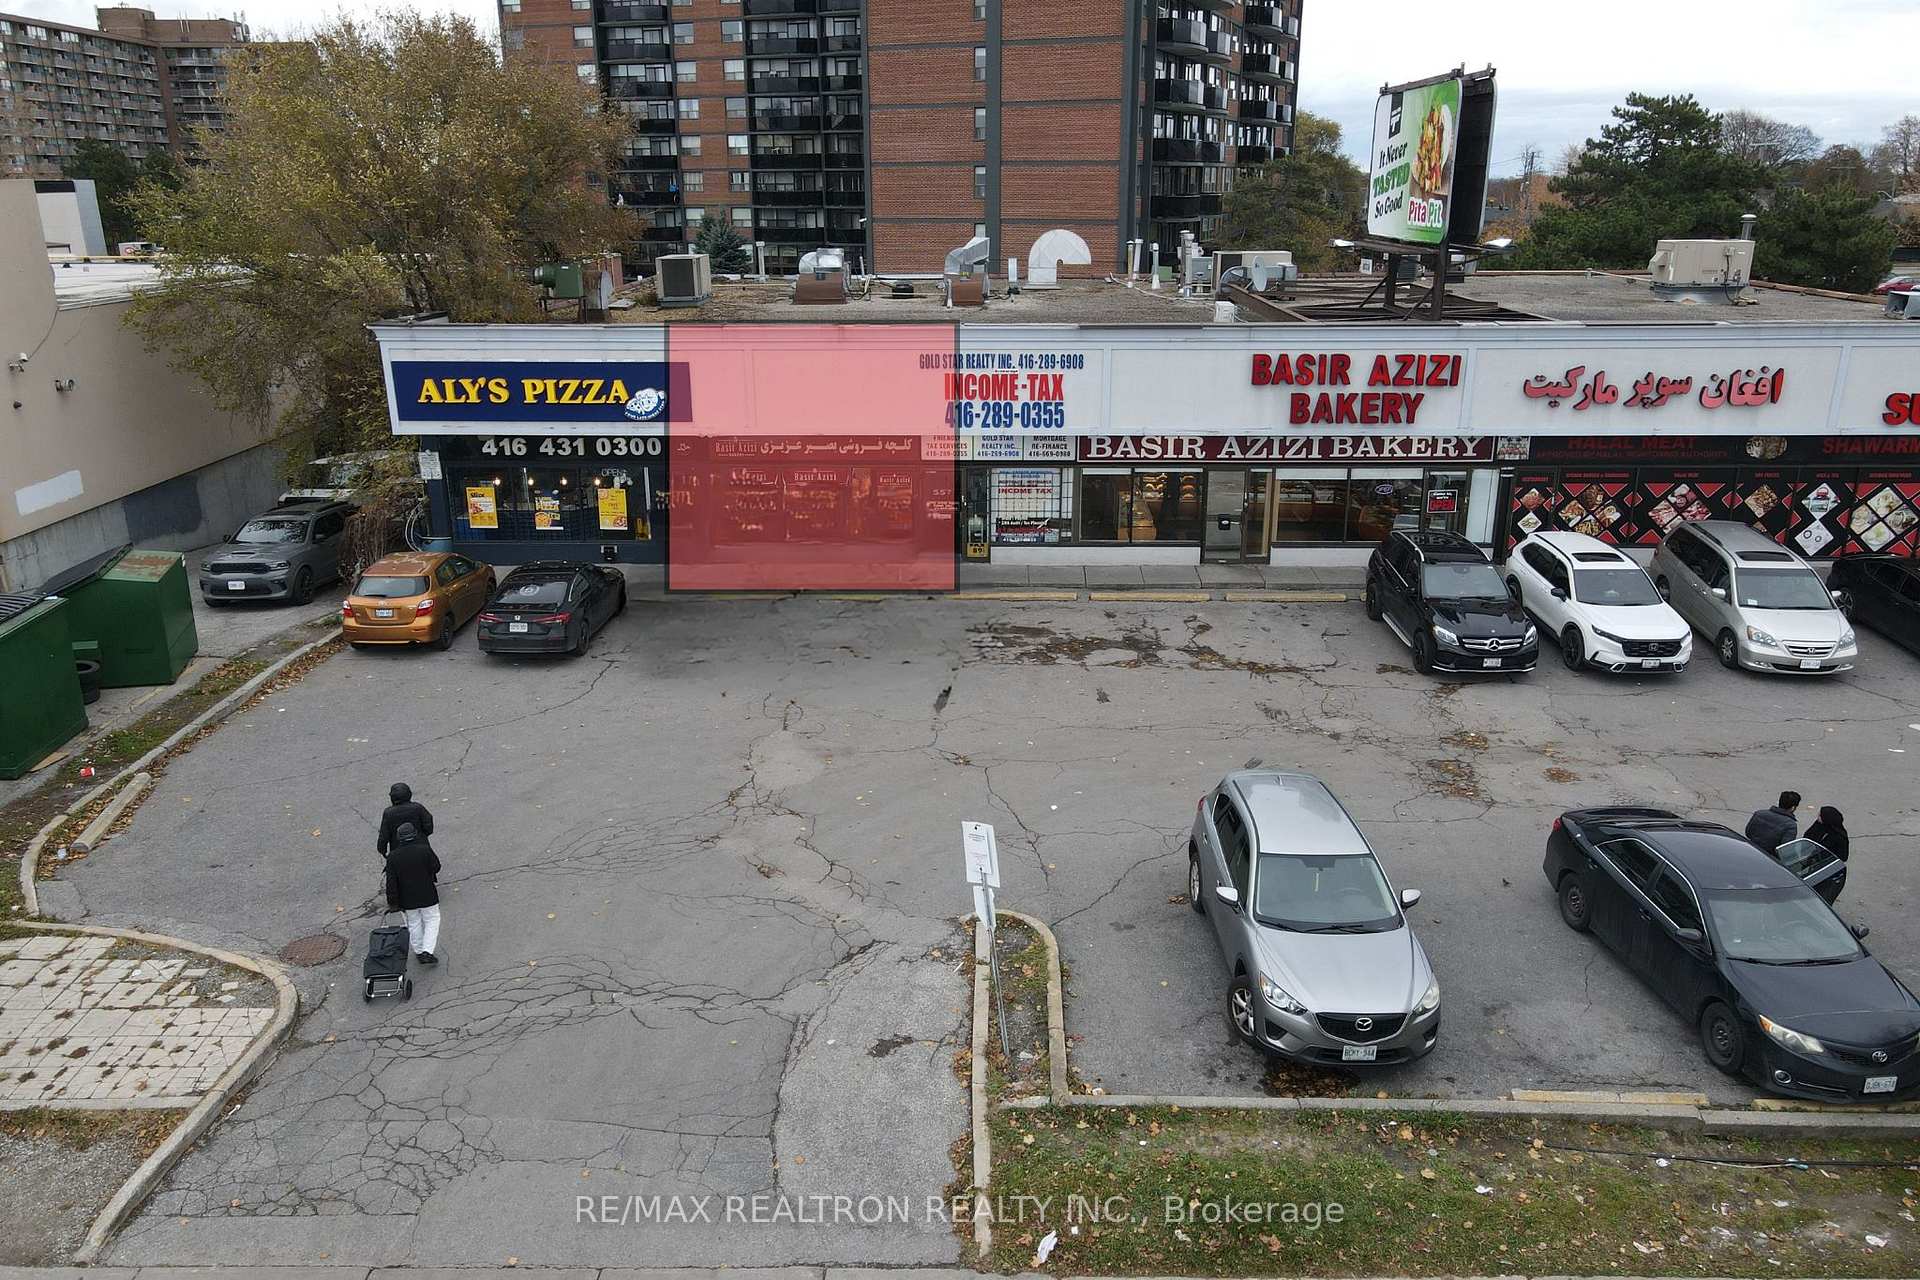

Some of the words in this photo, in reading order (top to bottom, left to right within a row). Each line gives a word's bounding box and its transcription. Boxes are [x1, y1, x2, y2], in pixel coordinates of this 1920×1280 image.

[1386, 142, 1408, 165] Never
[1373, 162, 1411, 198] TASTED
[1375, 200, 1384, 218] So
[1384, 190, 1403, 214] Good
[1408, 200, 1427, 223] Pita
[1428, 201, 1442, 225] Pit
[919, 353, 940, 369] GOLD
[942, 353, 963, 369] STAR
[965, 353, 996, 369] REALTY
[998, 353, 1016, 369] INC.
[1018, 353, 1084, 369] 416-289-6908
[1251, 353, 1351, 386] BASIR
[1367, 354, 1462, 387] AZIZI
[417, 376, 510, 404] ALY'S
[521, 379, 630, 404] PIZZA
[1623, 371, 1693, 410] سوپر
[1699, 365, 1785, 410] افغان
[944, 401, 1064, 428] 416-289-0355
[1289, 392, 1425, 425] BAKERY
[481, 437, 528, 456] 416
[539, 437, 586, 456] 431
[596, 437, 662, 456] 0300
[1087, 436, 1206, 459] BASIR
[1216, 436, 1322, 459] AZIZI
[1329, 436, 1484, 458] BAKERY
[1641, 438, 1698, 449] MEAT
